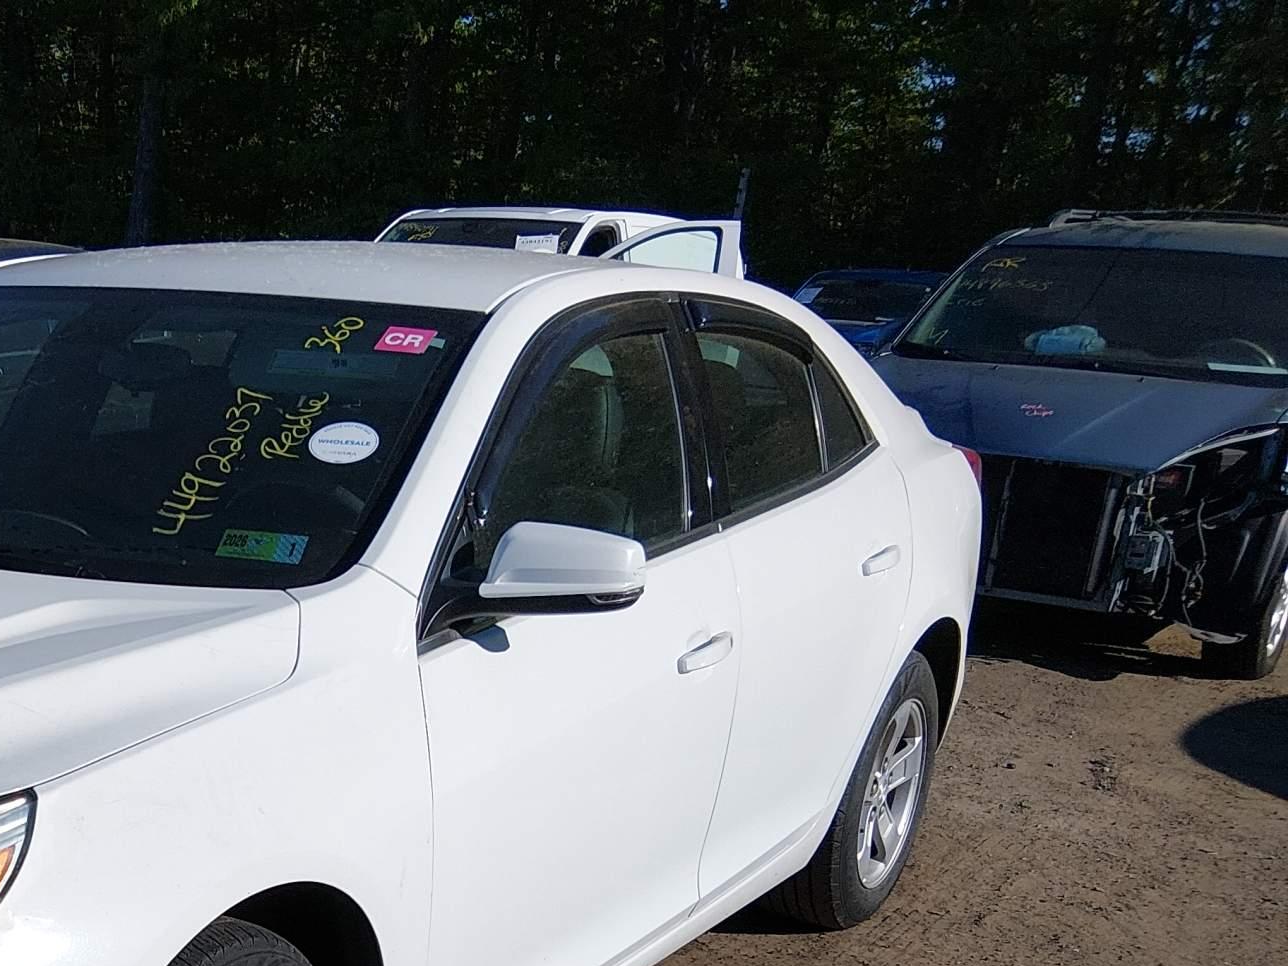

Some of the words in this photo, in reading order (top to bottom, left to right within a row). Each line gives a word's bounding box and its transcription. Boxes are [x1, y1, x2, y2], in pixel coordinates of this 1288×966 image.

[304, 316, 364, 354] 360
[384, 332, 424, 347] CR
[318, 438, 371, 447] WHOLESALE
[152, 387, 273, 535] 44922037
